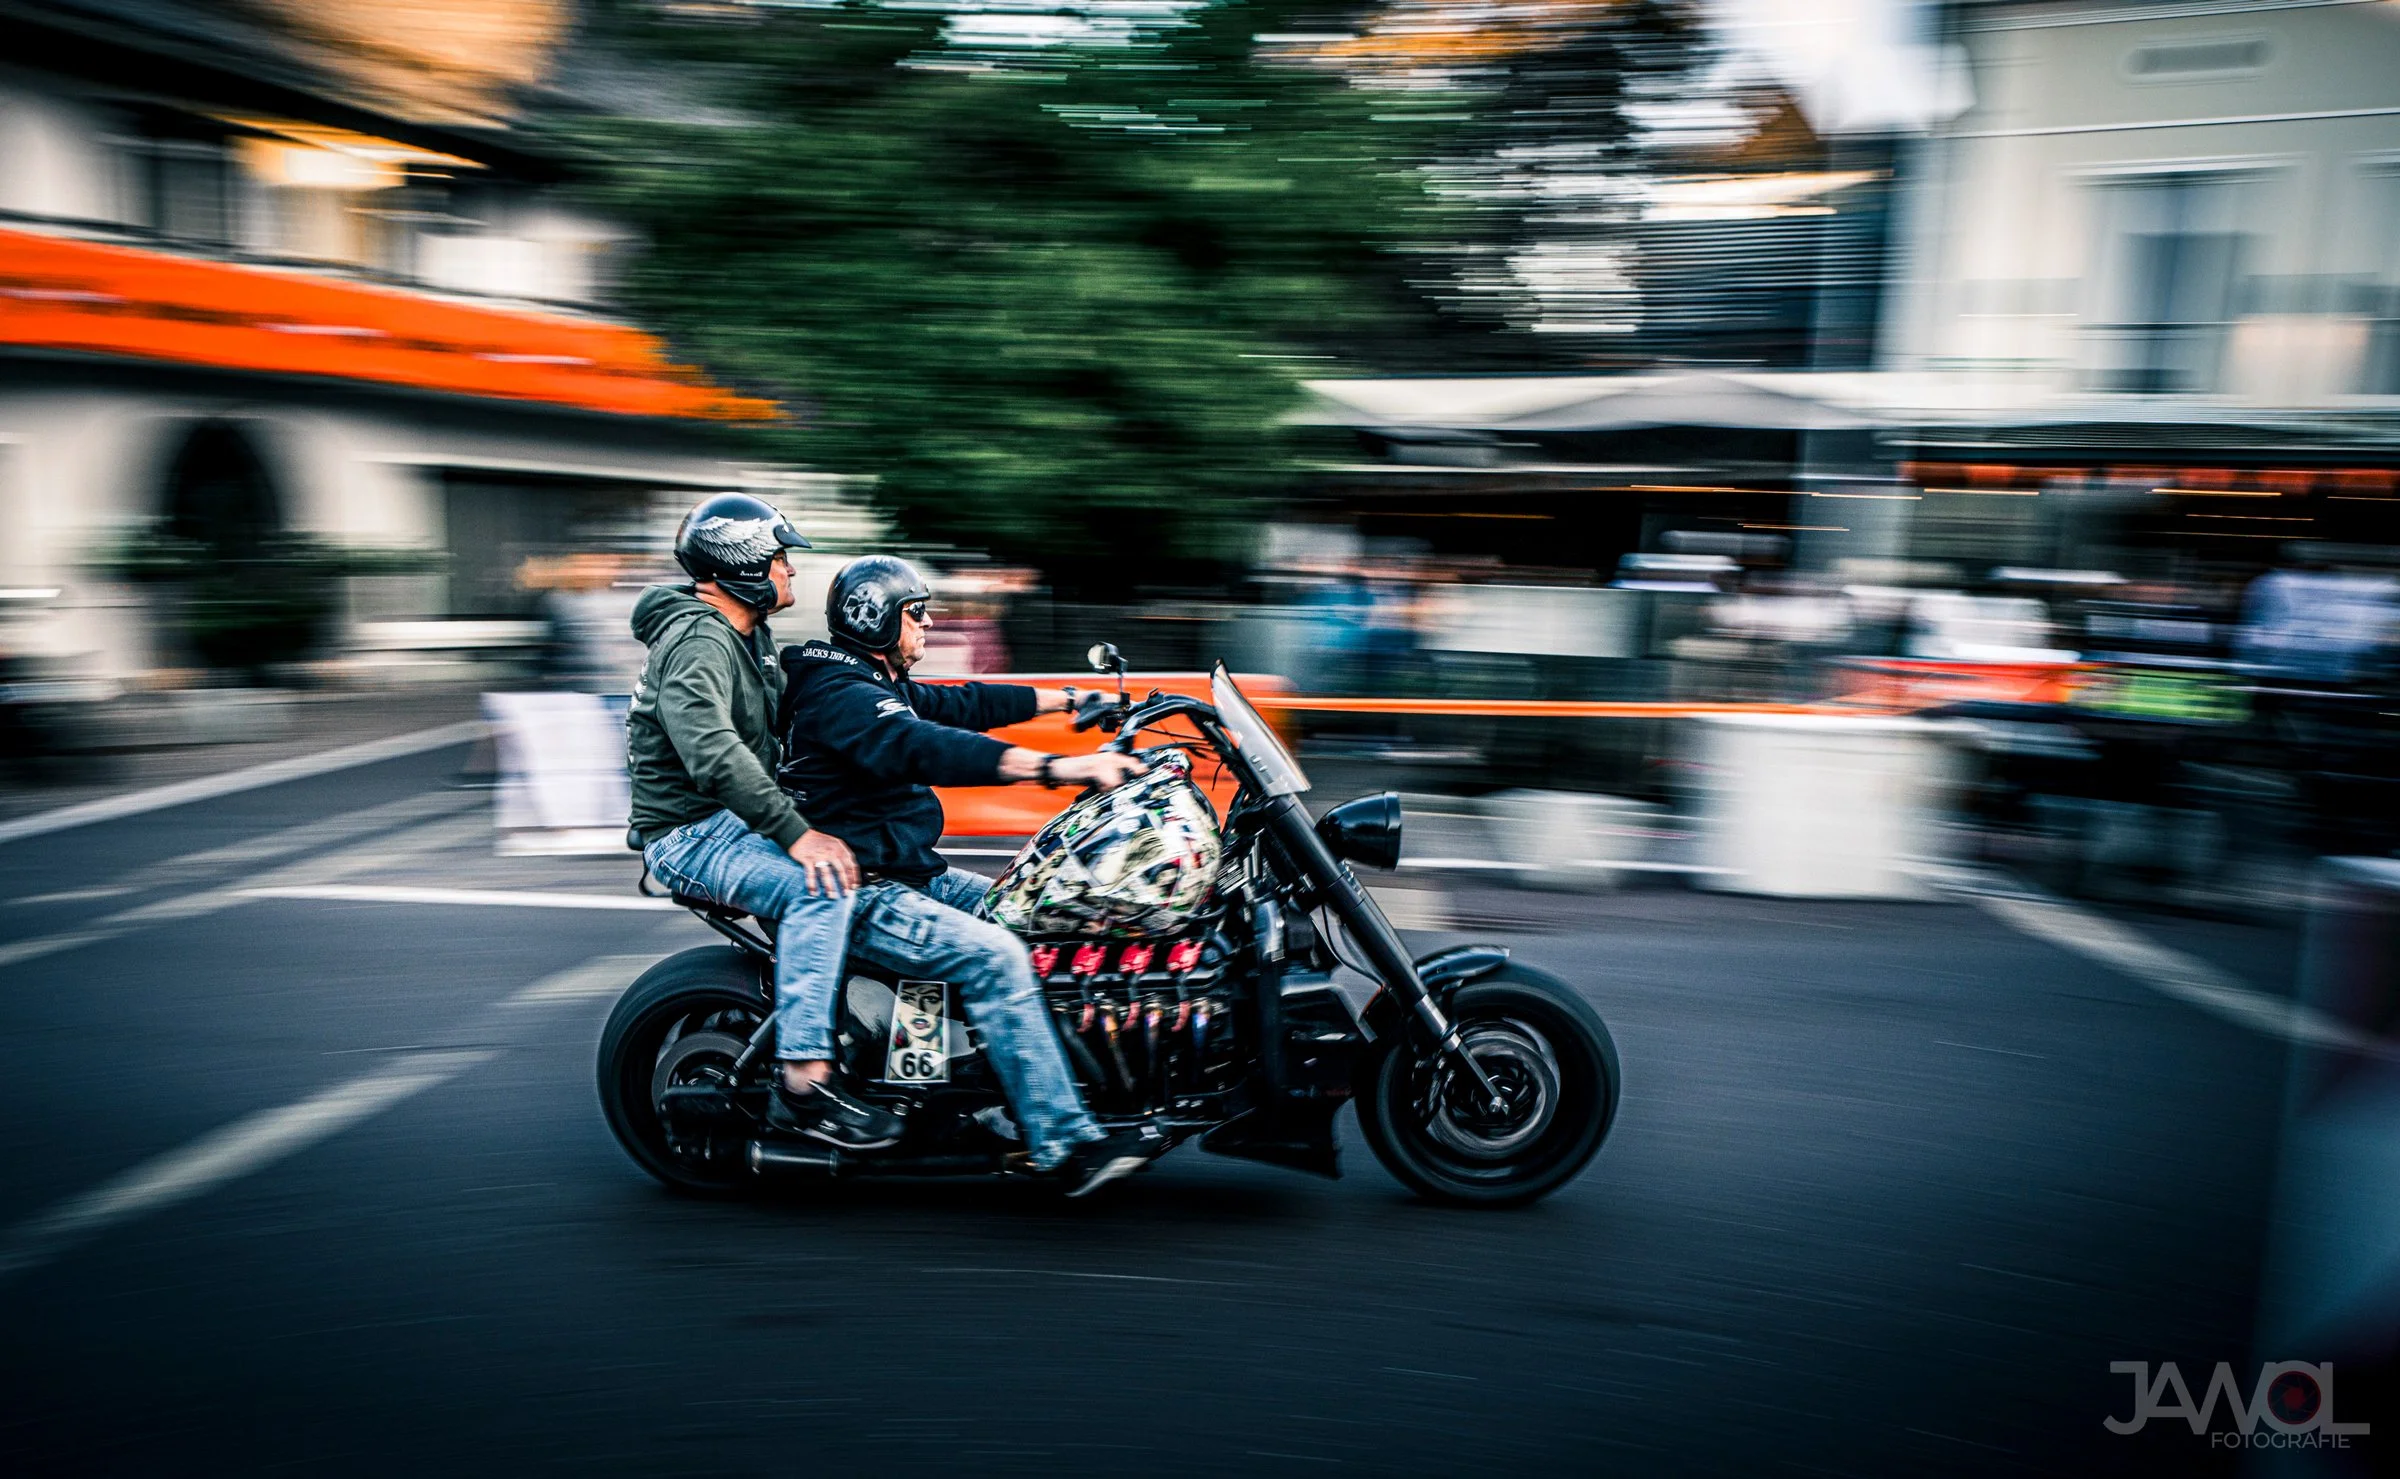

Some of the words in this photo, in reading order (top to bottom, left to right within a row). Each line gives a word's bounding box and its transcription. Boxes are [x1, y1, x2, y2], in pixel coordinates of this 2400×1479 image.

[802, 648, 829, 658] JACKS
[828, 651, 846, 661] INN
[901, 1052, 935, 1078] 66
